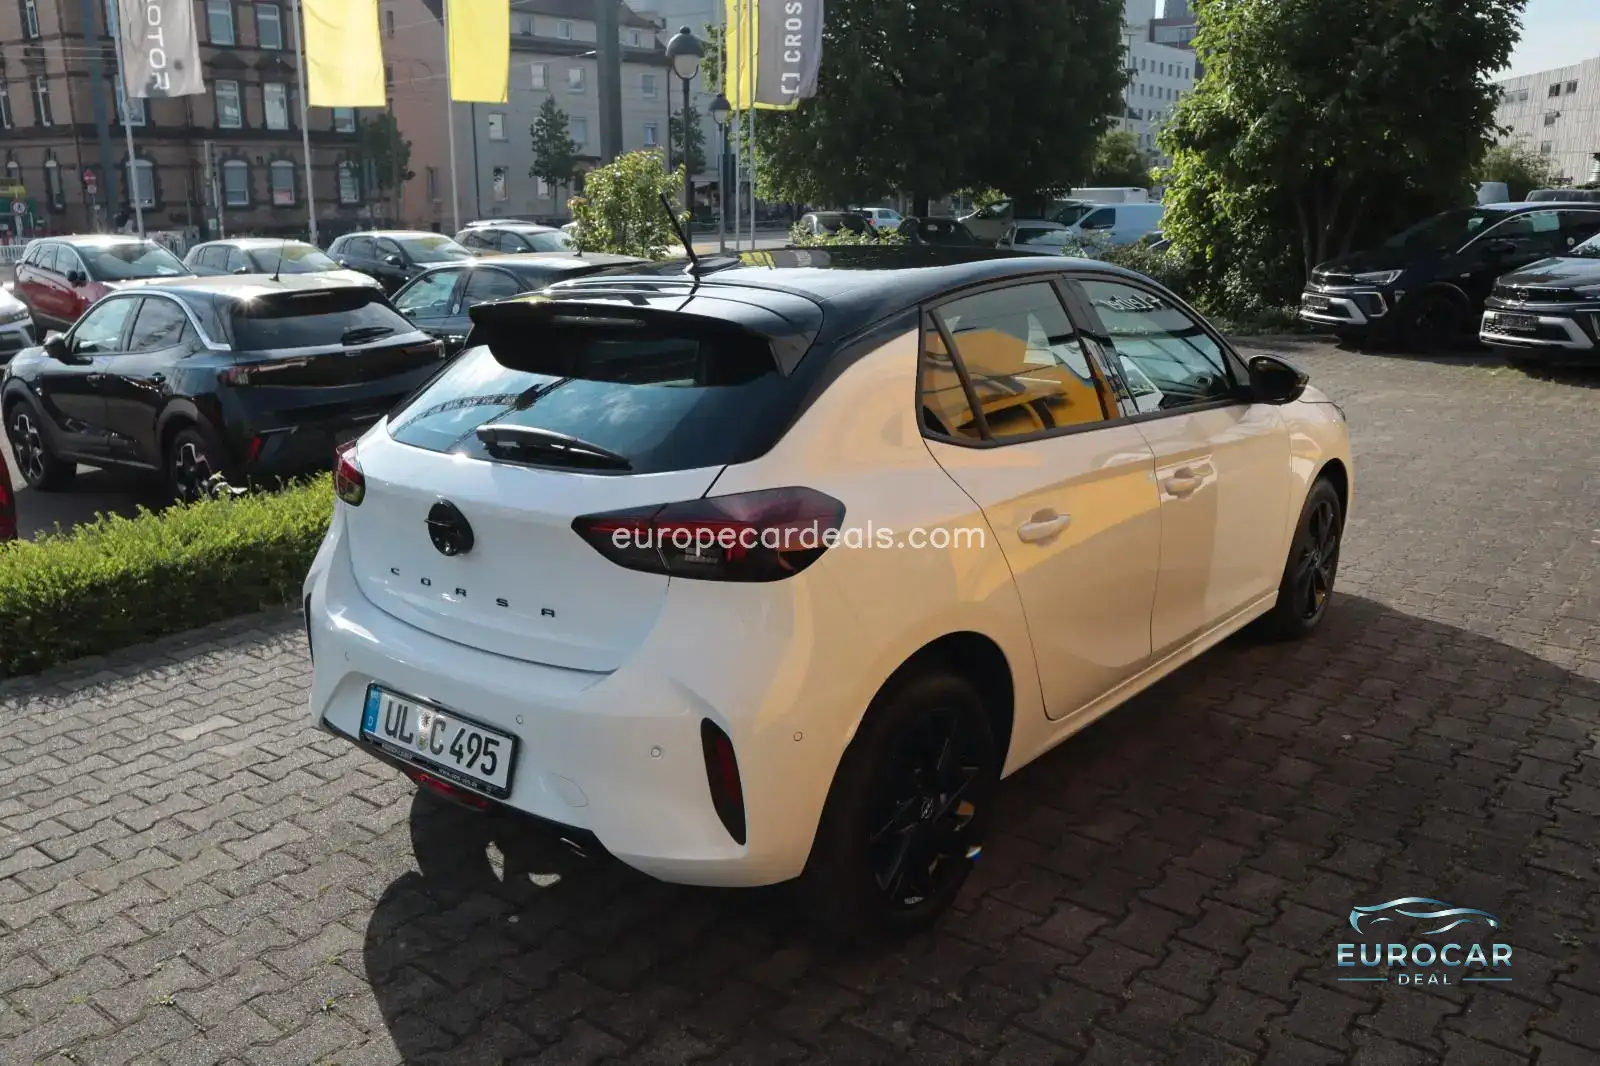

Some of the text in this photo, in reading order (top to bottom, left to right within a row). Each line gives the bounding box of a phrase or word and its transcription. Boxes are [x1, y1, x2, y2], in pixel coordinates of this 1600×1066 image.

[147, 0, 170, 90] OTOR
[390, 567, 556, 618] CORSA
[384, 700, 414, 744] UL
[430, 716, 446, 755] C
[449, 729, 500, 776] 495
